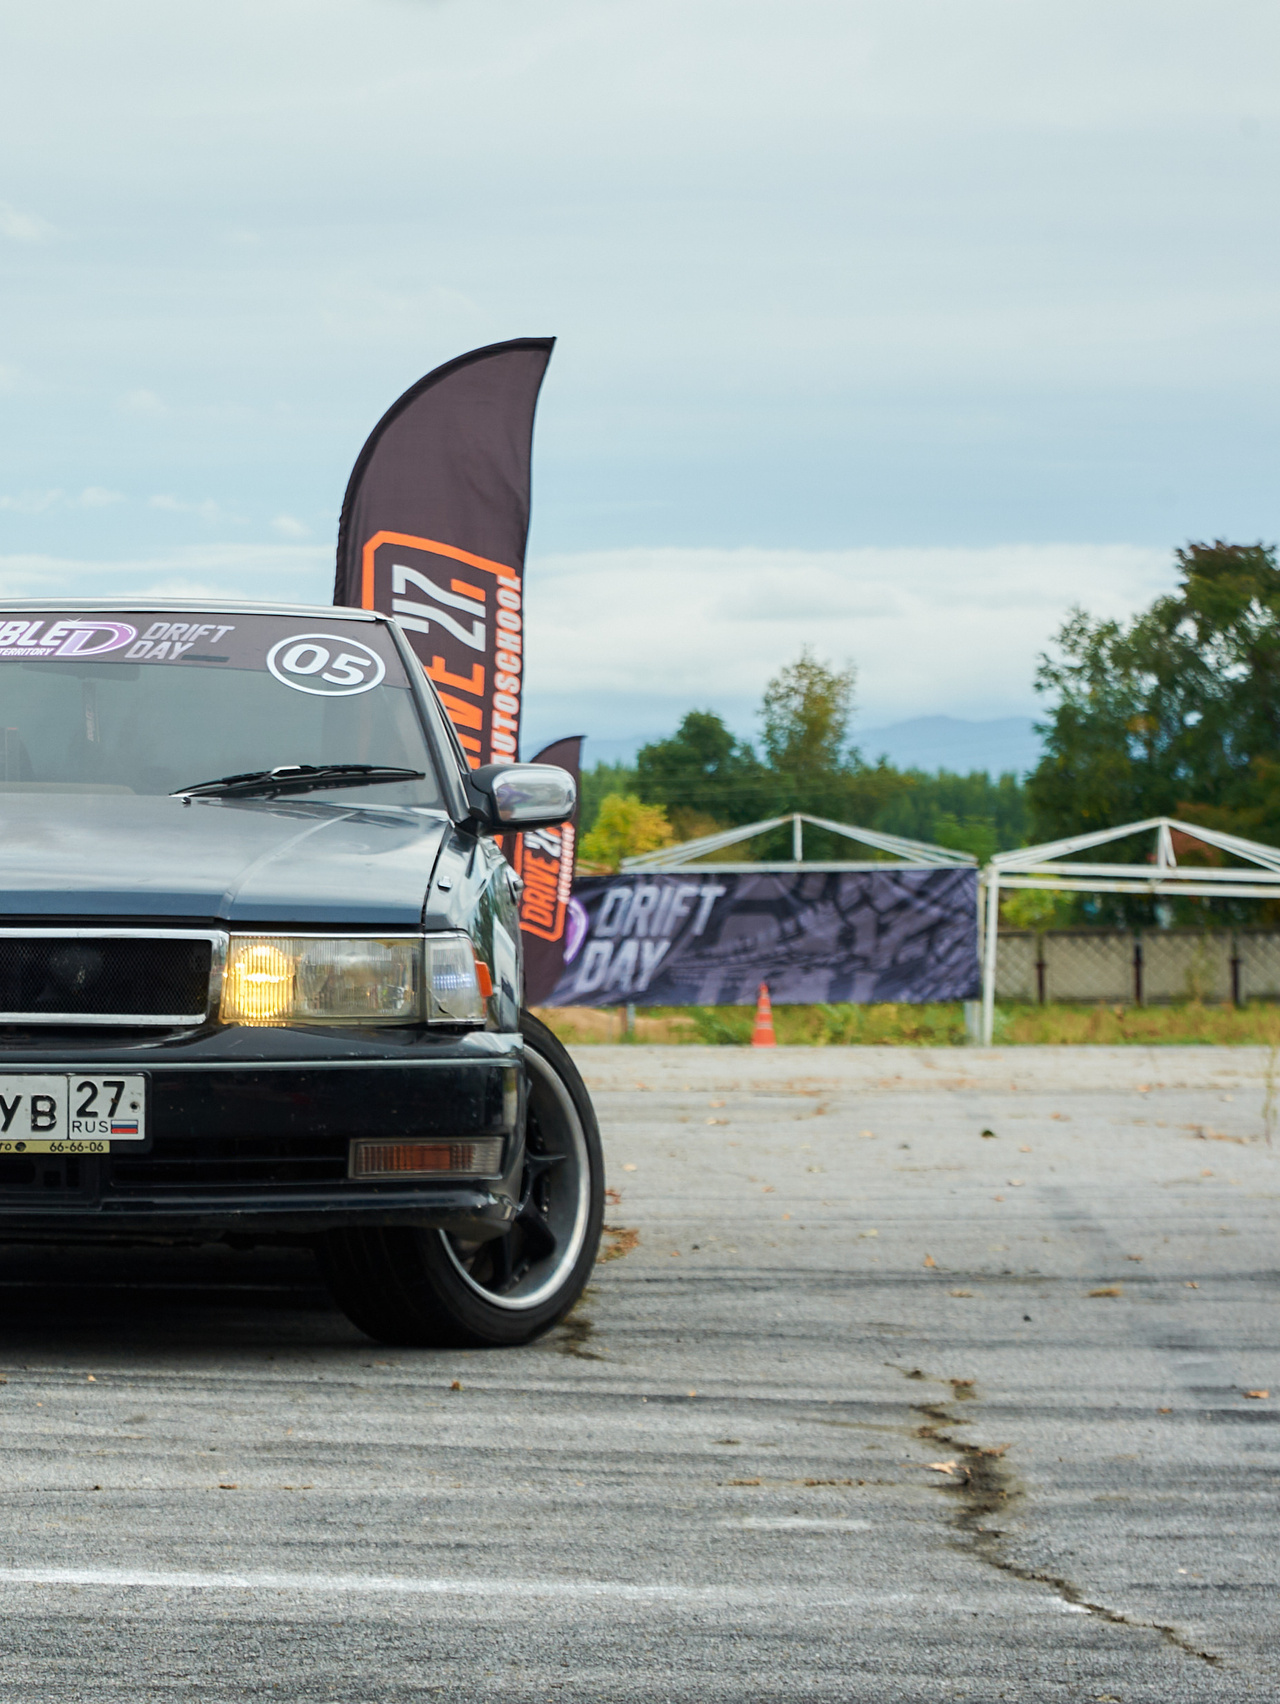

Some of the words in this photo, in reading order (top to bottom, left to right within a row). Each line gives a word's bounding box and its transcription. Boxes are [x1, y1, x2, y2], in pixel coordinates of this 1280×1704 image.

[124, 640, 195, 661] DAY
[141, 621, 235, 643] DRIFT
[282, 643, 372, 686] 05
[521, 849, 560, 928] DRIVE
[594, 884, 727, 938] DRIFT
[574, 939, 671, 993] DAY
[76, 1080, 126, 1119] 27
[49, 1141, 105, 1152] 66-66-06
[72, 1120, 109, 1134] RUS
